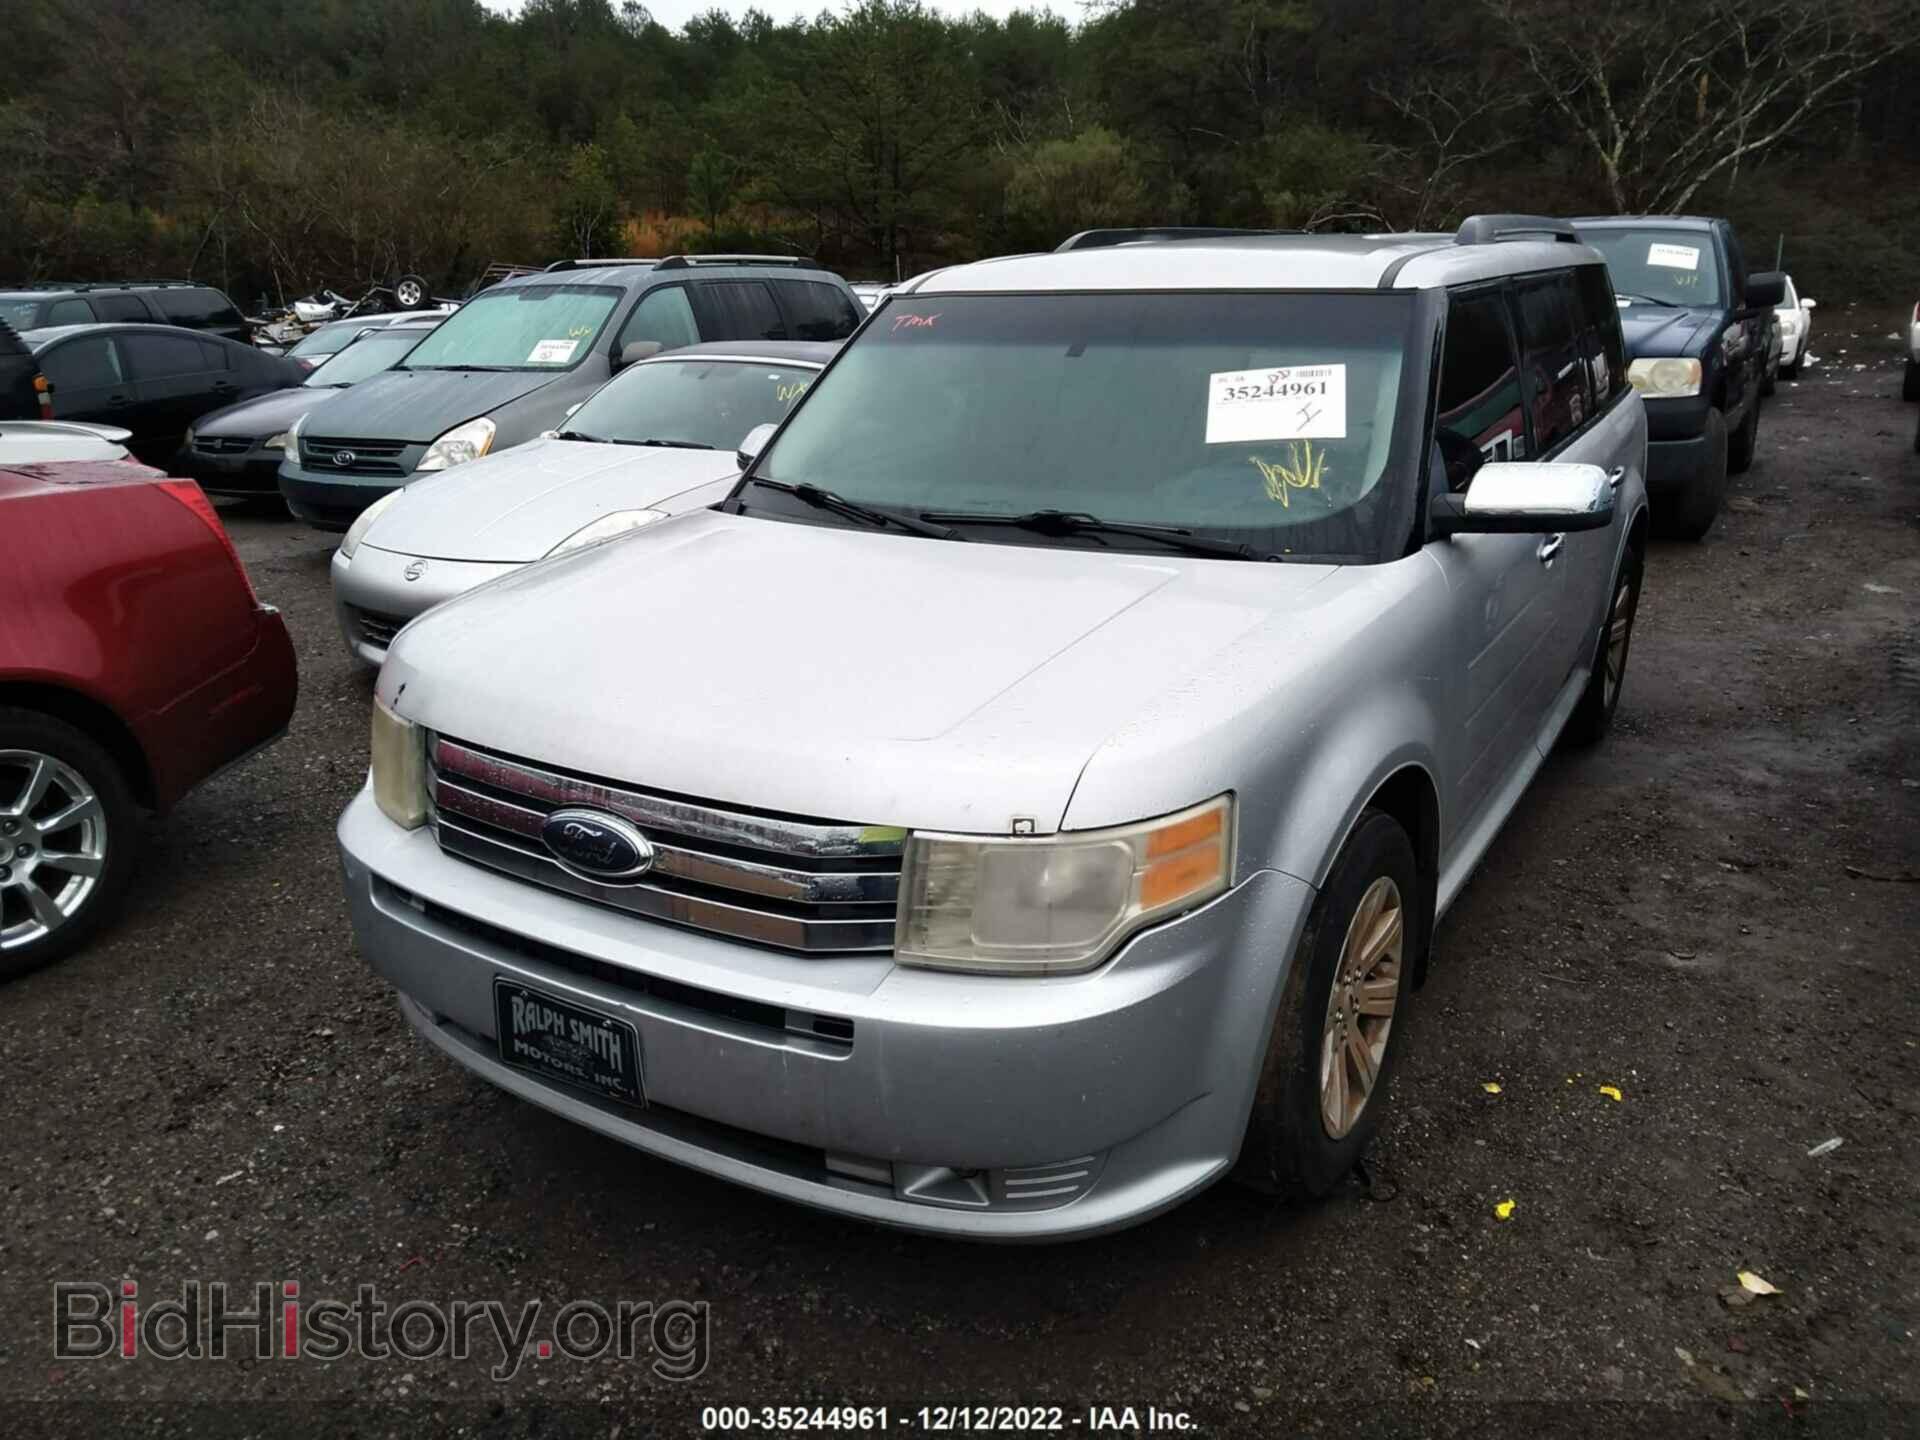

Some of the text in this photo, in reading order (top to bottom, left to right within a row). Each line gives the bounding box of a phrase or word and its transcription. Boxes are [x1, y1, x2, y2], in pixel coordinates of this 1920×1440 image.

[1223, 381, 1327, 401] 35244961
[511, 995, 623, 1073] RALPH SMITH
